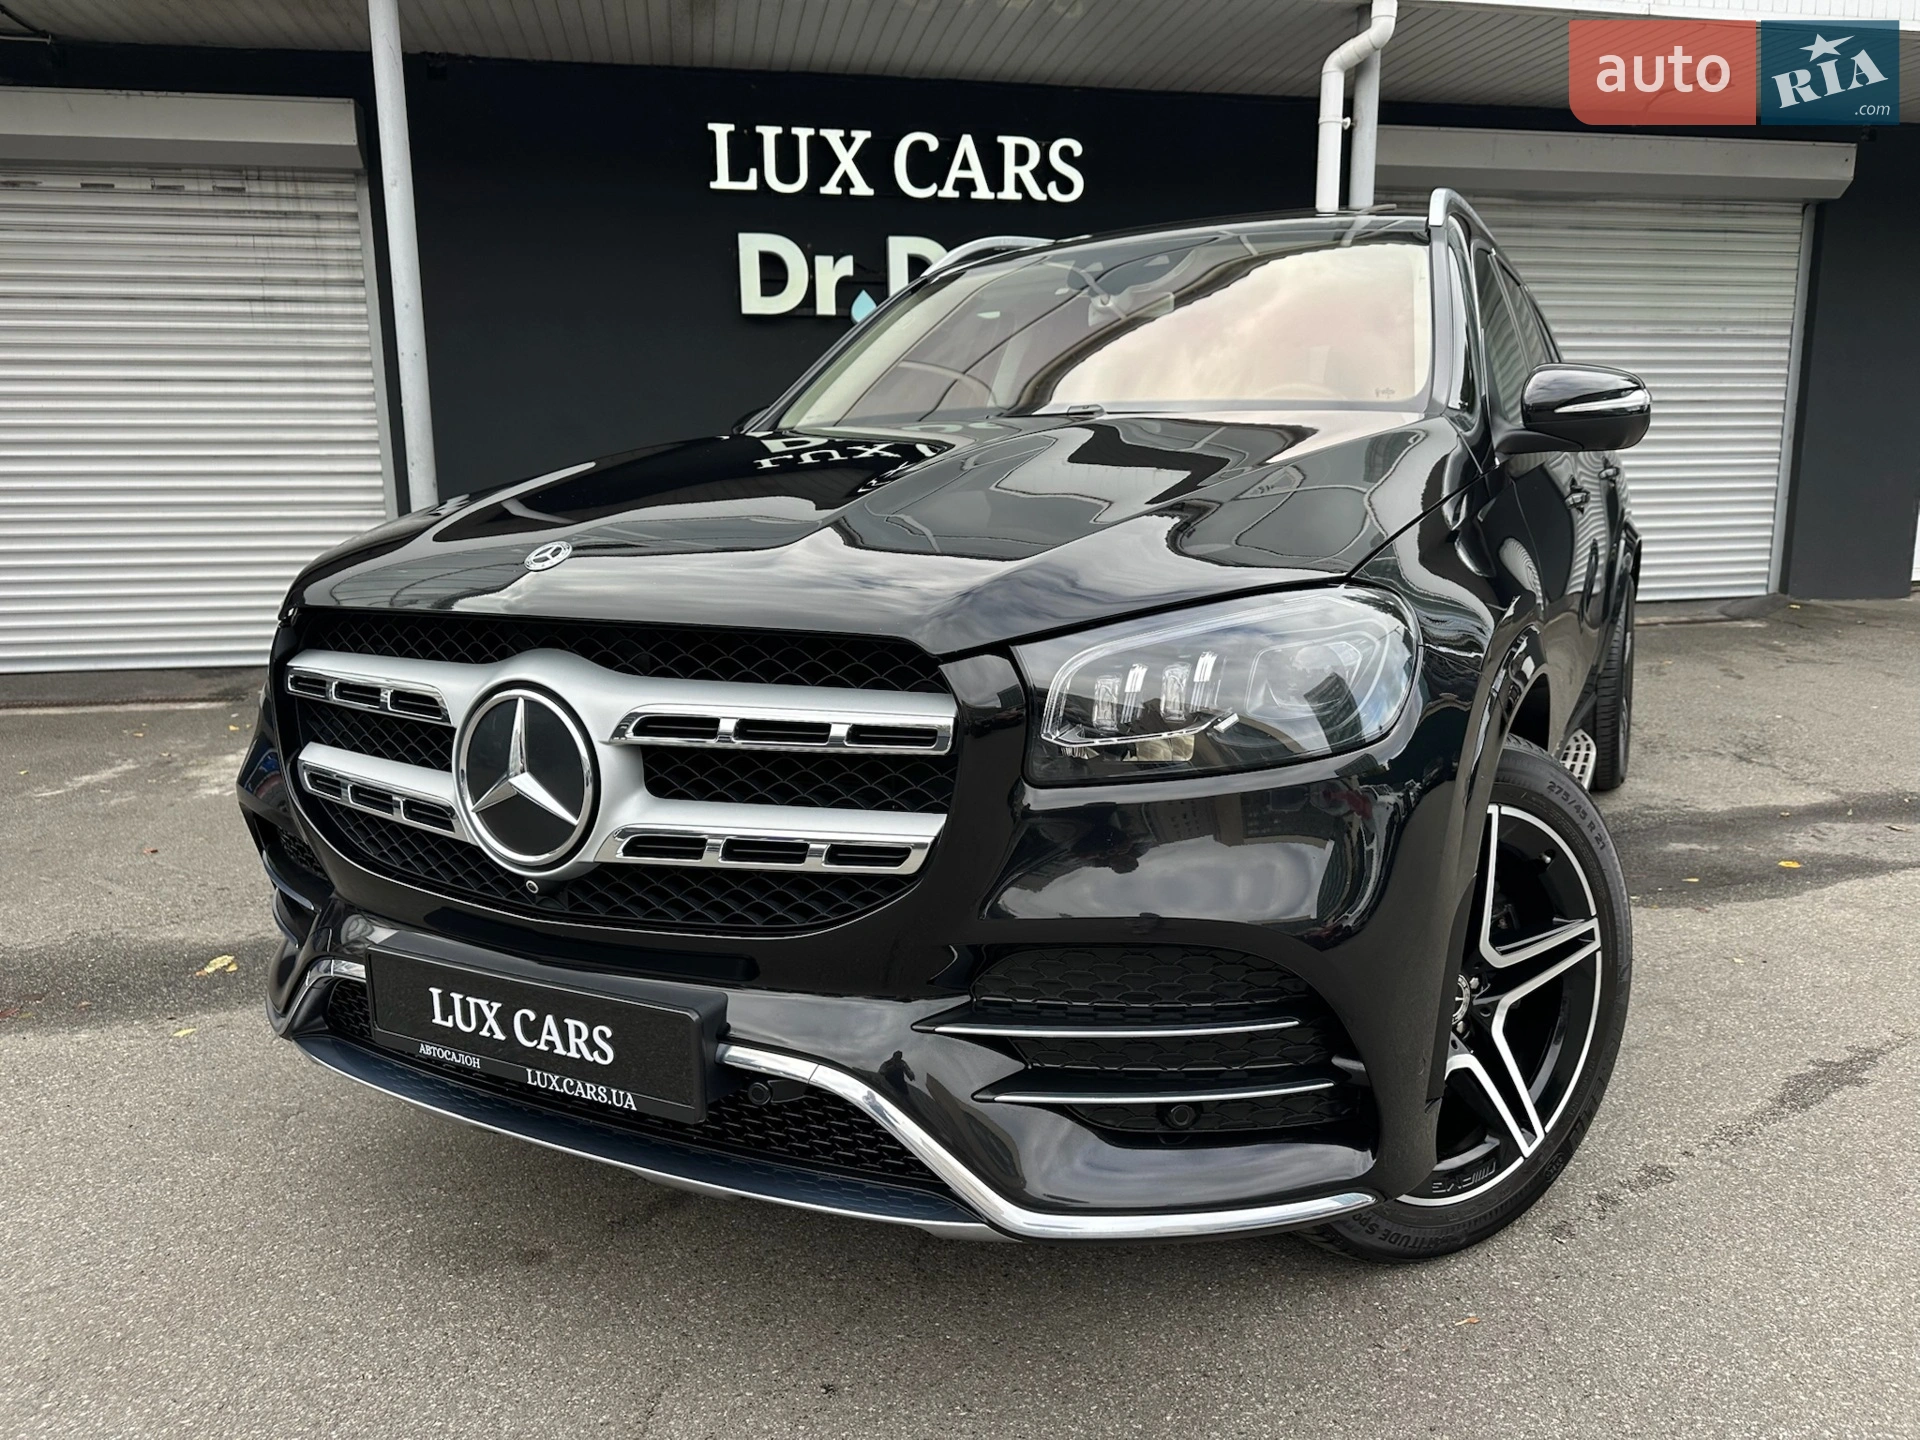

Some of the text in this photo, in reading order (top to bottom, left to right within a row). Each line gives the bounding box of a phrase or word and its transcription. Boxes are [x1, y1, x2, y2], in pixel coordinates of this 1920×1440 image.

[707, 122, 1085, 203] LUX CARS
[418, 1043, 481, 1069] АВТОСАЛОН
[428, 987, 615, 1066] LUX CARS
[525, 1068, 638, 1111] LUX.CARS.UA
